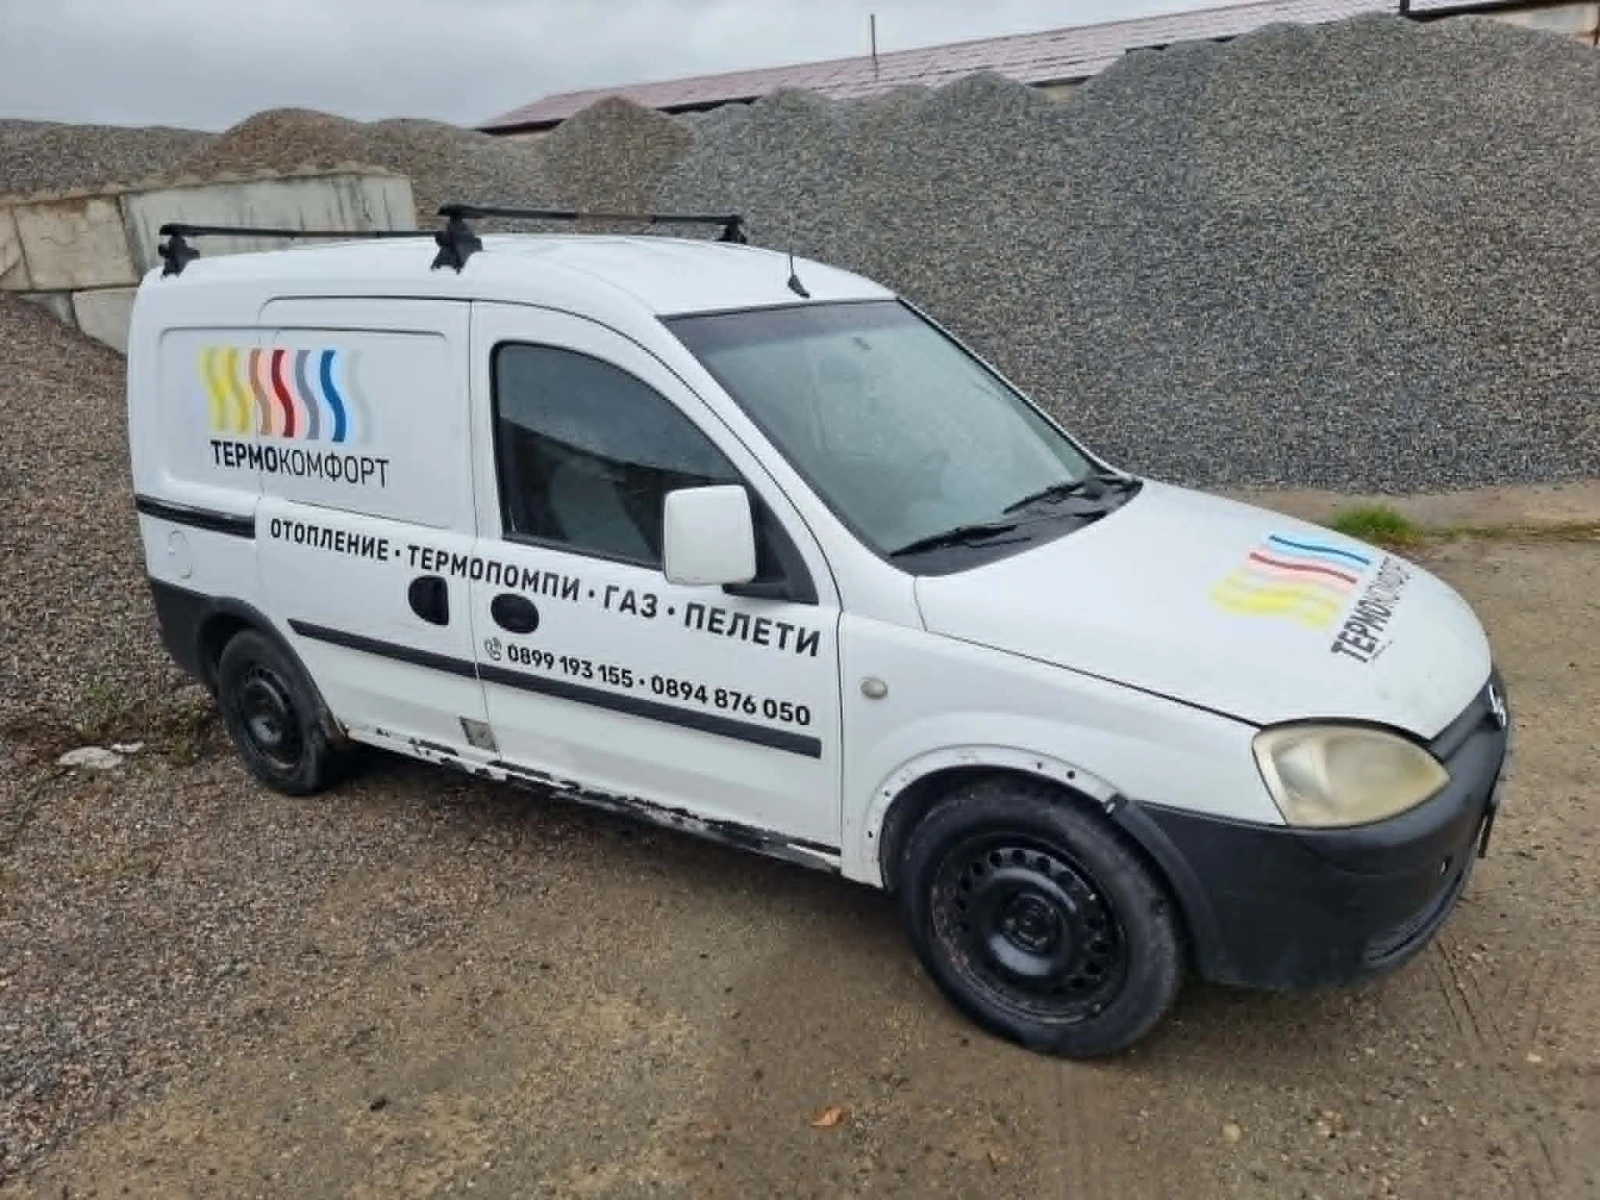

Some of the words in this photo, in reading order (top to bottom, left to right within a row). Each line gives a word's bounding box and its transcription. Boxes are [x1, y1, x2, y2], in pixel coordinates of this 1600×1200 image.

[210, 439, 389, 488] ТЕРМОКОМФОРТ
[270, 518, 389, 561] ОТОПЛЕНИЕ
[407, 545, 581, 601] ТЕРМОПОМПИ
[604, 585, 658, 619] ГАЗ
[684, 602, 821, 657] ПЕЛЕТИ
[507, 643, 555, 669] 0899
[559, 655, 593, 679] 193
[598, 664, 634, 688] 155
[651, 674, 708, 705] 0894
[714, 688, 757, 715] 876
[763, 699, 811, 726] 050
